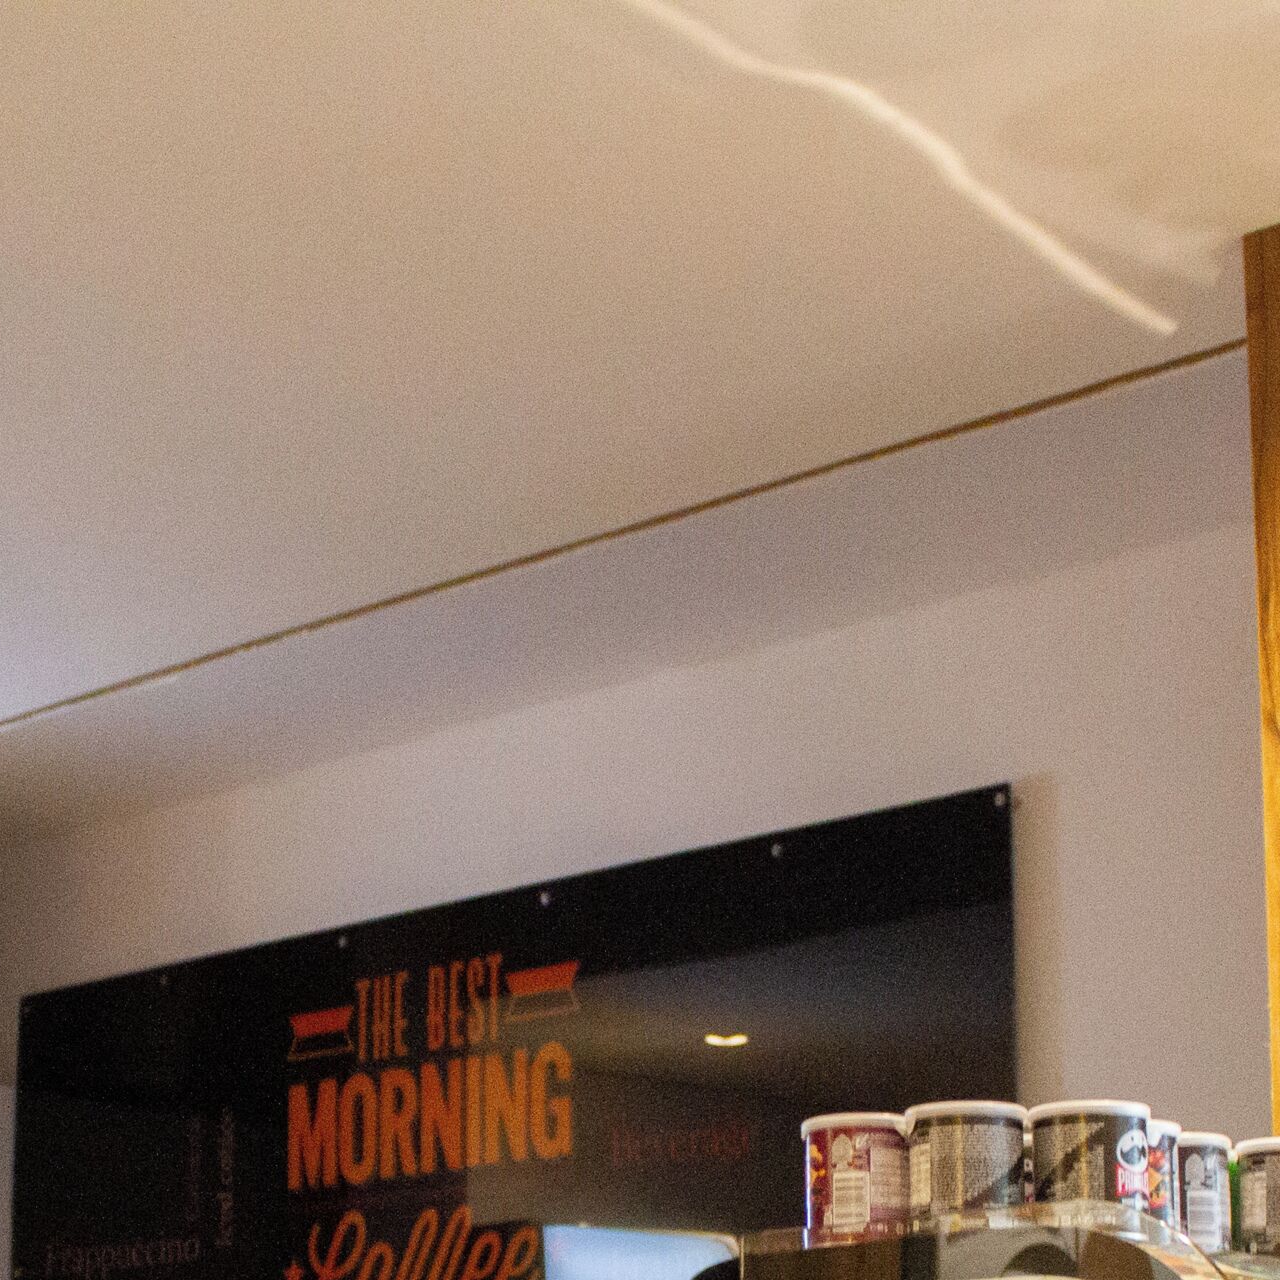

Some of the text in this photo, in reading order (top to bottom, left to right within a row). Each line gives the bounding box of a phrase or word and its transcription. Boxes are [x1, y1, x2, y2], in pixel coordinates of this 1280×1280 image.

[355, 953, 503, 1063] THE BEST
[287, 1041, 573, 1191] MORNING
[44, 1235, 201, 1280] Frappuccino
